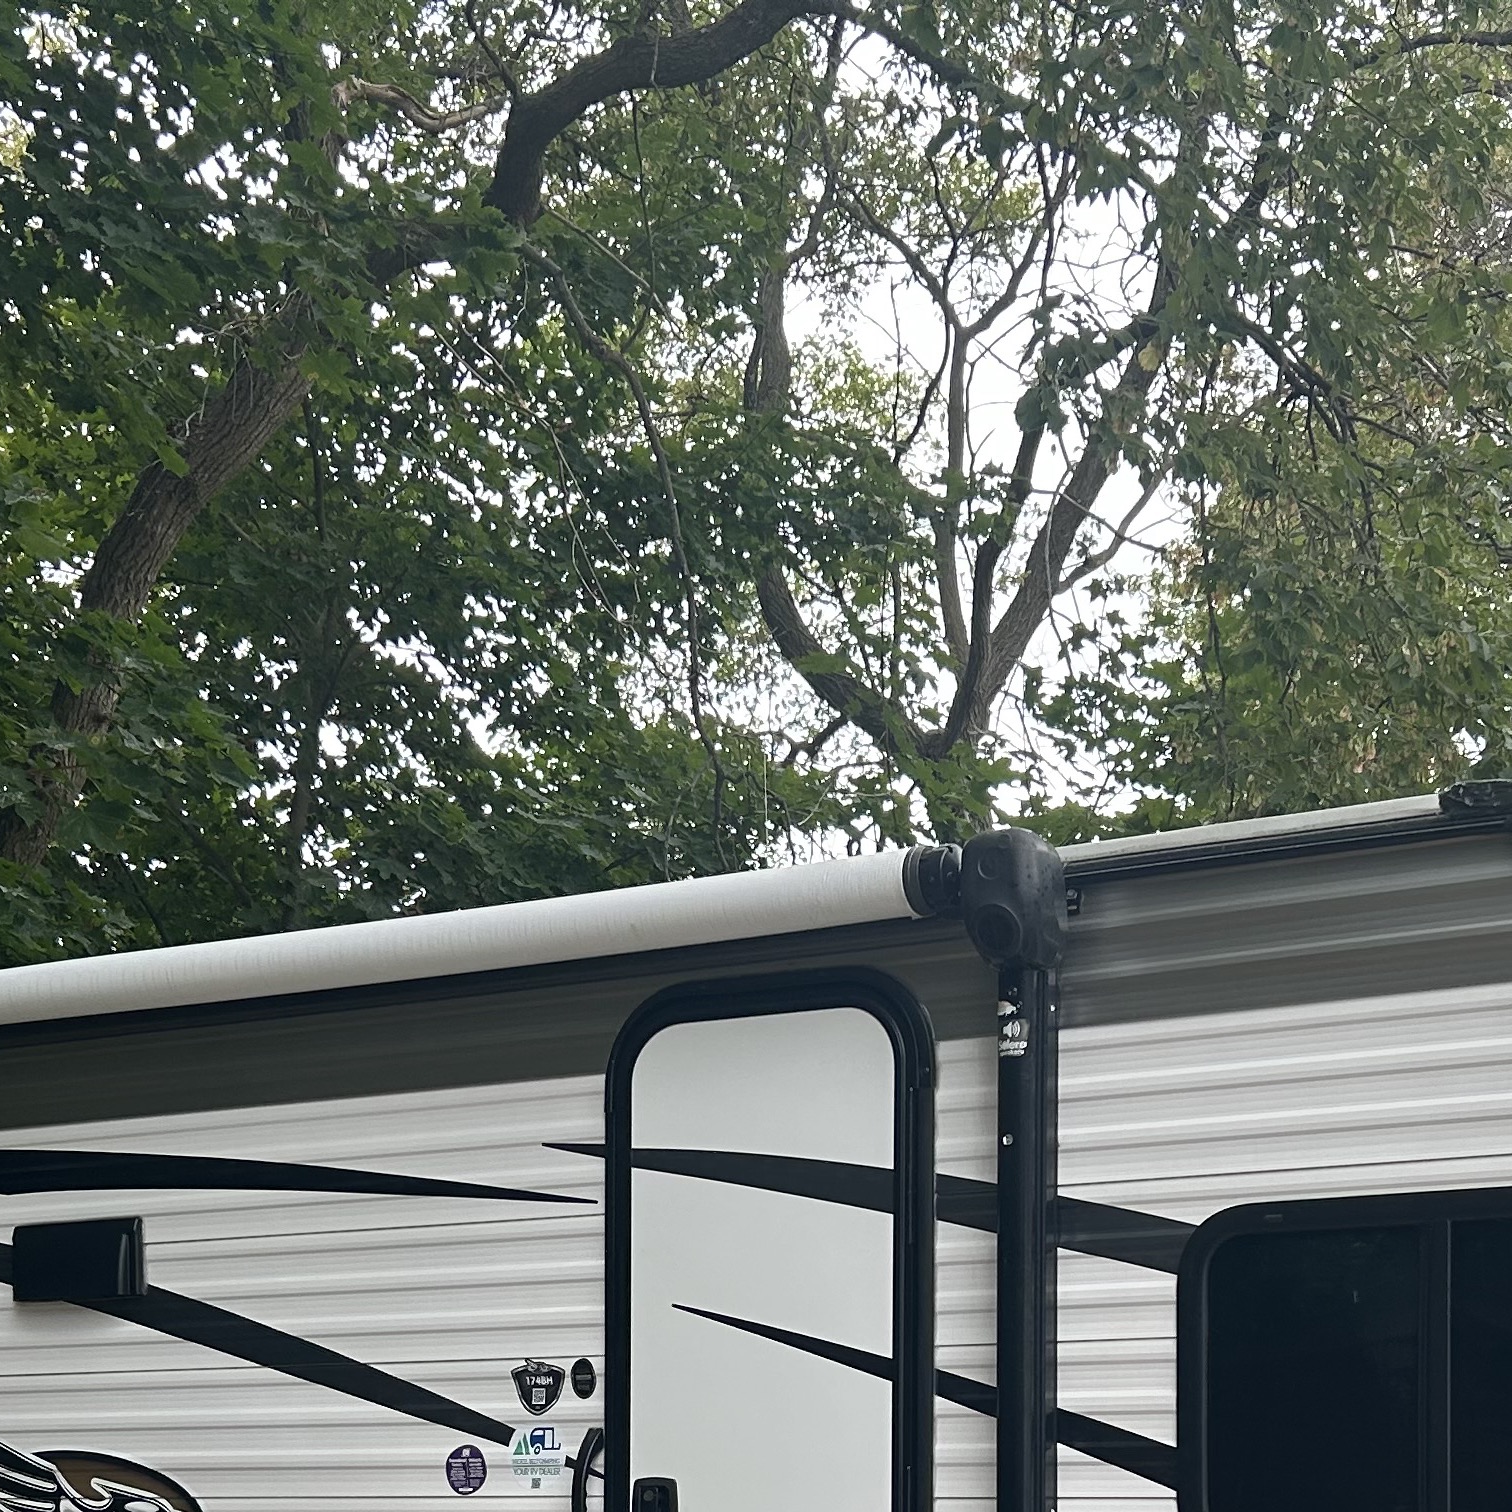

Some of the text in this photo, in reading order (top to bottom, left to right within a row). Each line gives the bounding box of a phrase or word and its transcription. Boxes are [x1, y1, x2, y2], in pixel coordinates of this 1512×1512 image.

[525, 1375, 554, 1386] 174BH
[513, 1467, 561, 1476] YOUR RV DEALER
